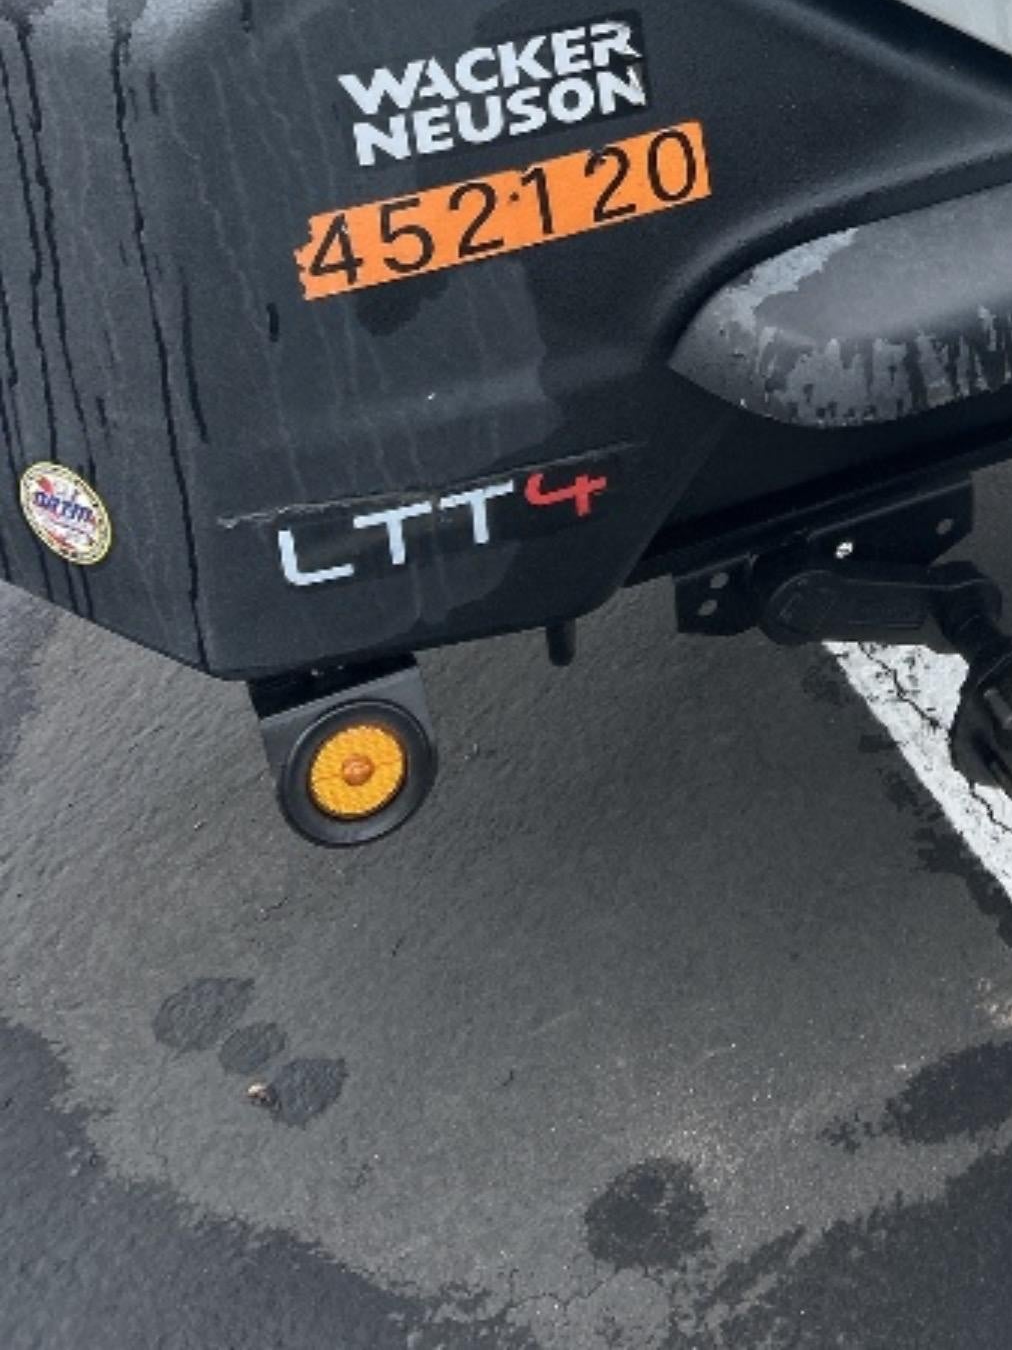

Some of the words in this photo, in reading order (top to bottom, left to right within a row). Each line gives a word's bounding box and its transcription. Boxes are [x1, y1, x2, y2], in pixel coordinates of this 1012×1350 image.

[337, 20, 643, 116] WACKER
[353, 63, 647, 167] NEUSON
[308, 128, 698, 286] 452120
